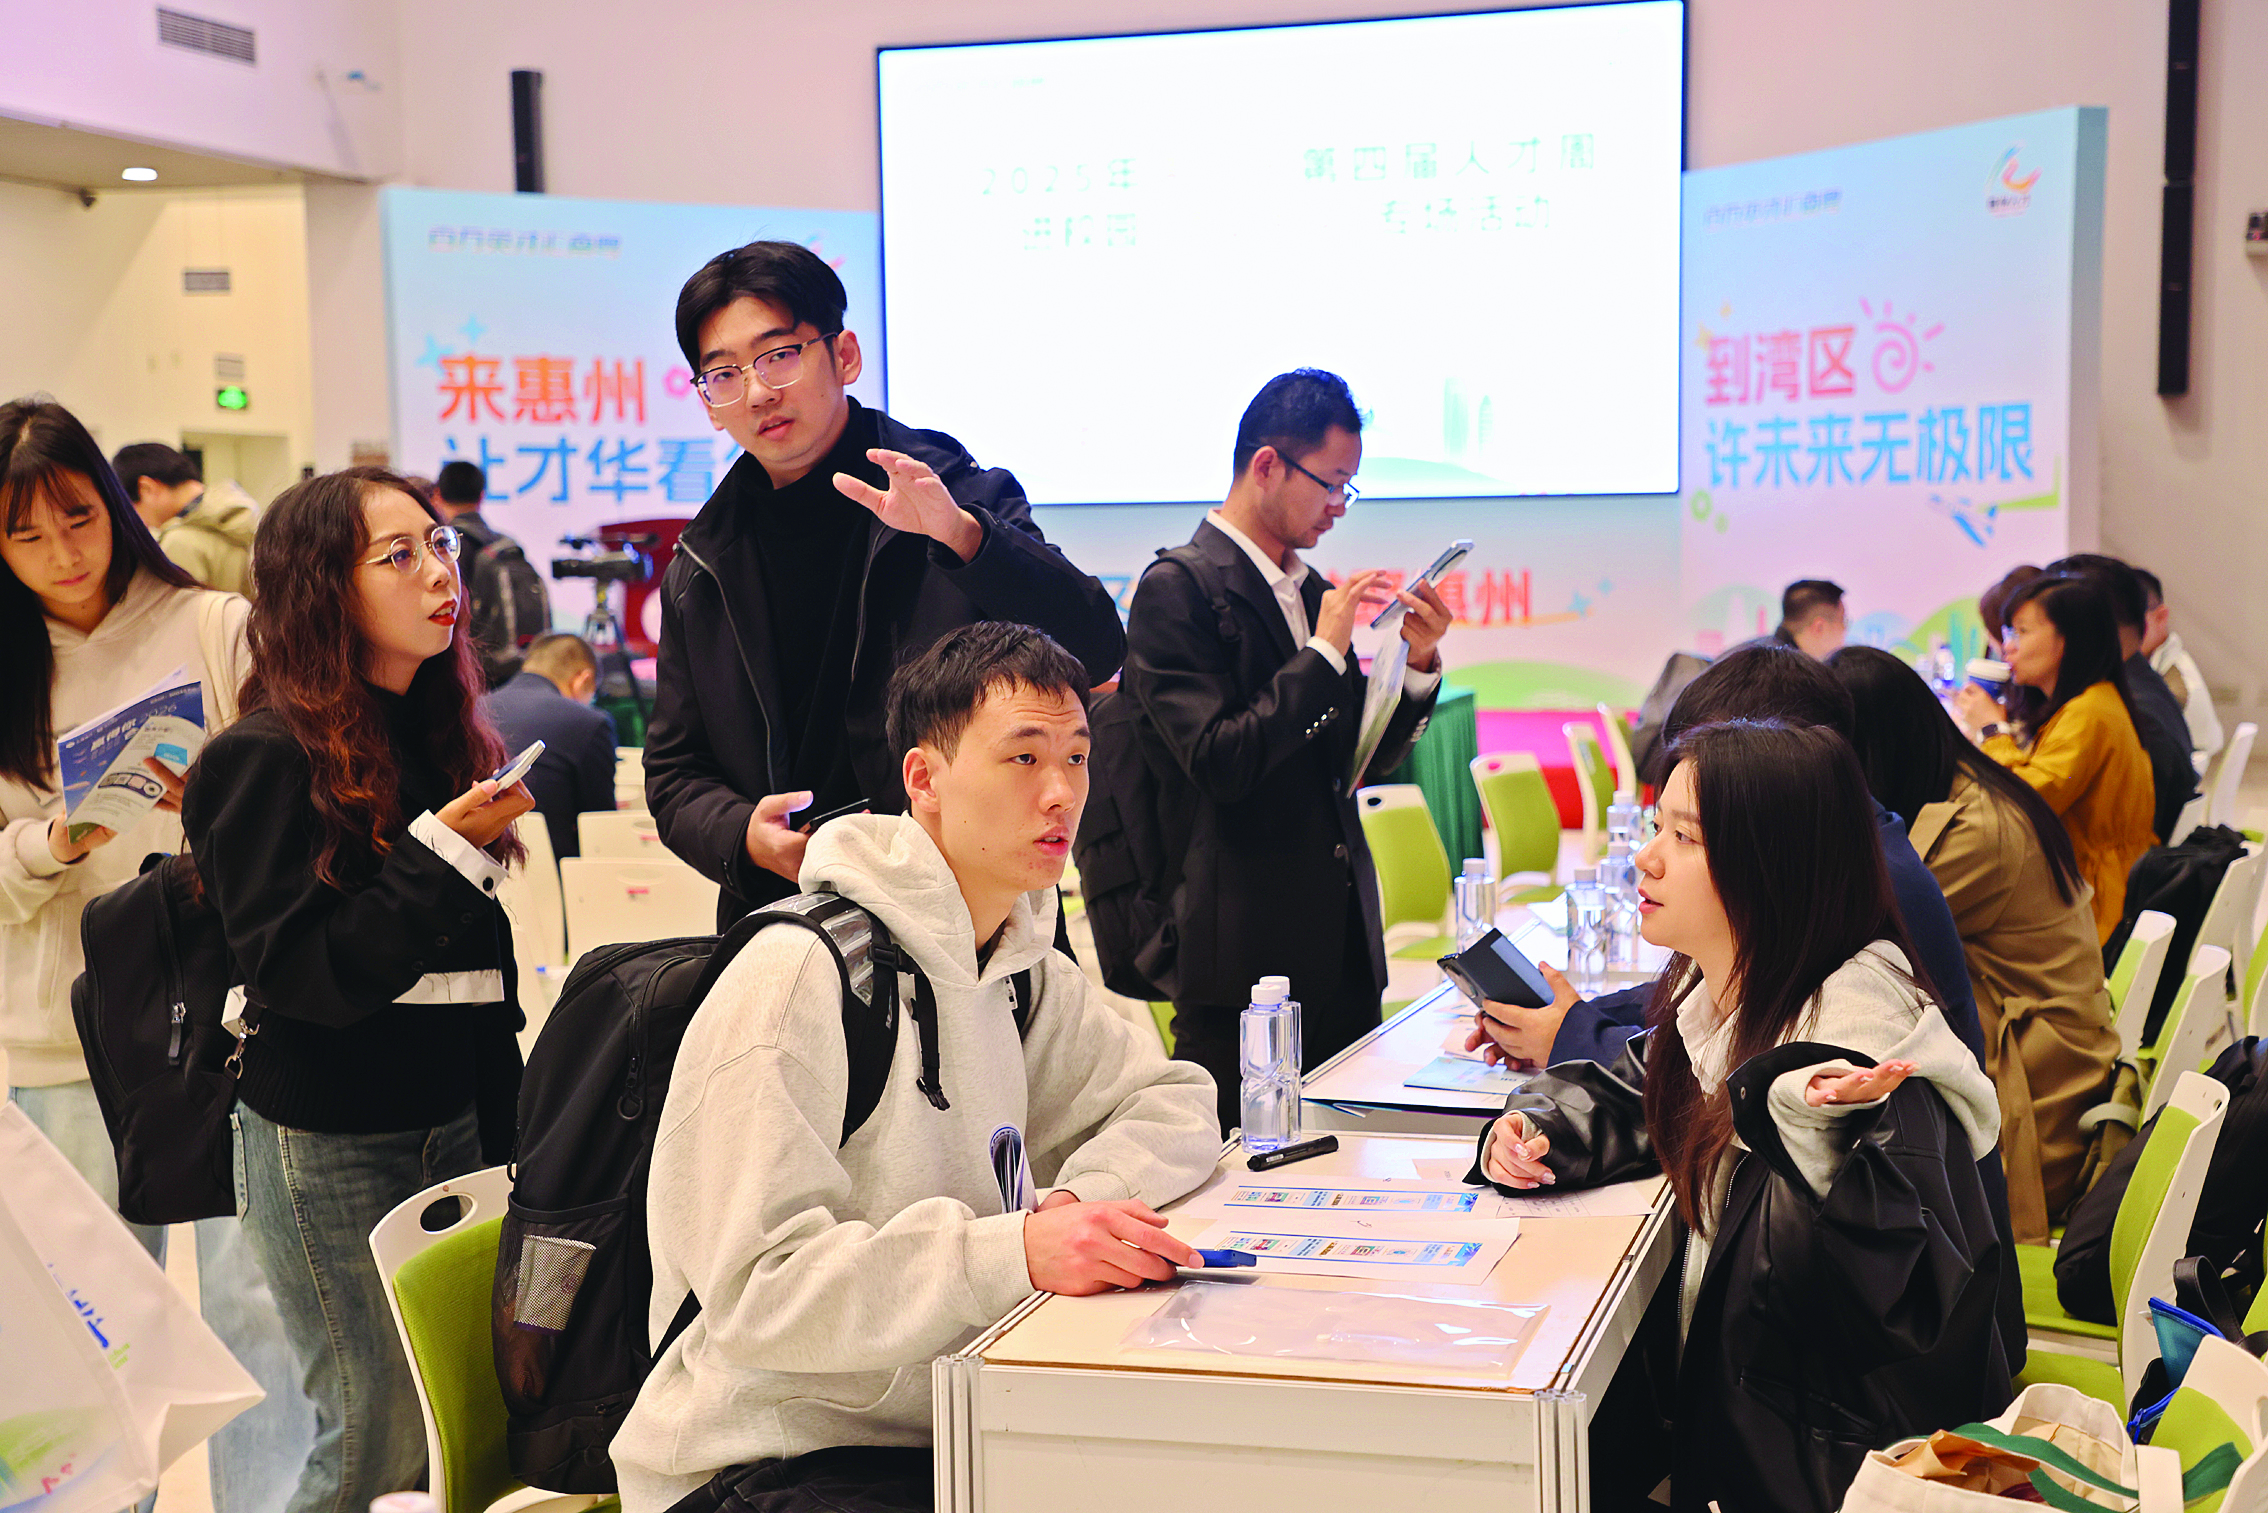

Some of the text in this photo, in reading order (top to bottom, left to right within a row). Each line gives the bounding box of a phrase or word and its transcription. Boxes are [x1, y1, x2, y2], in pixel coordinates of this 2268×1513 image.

[1302, 132, 1595, 183] 第四届人才周
[437, 354, 648, 427] 来惠州
[1704, 324, 1856, 407] 到湾区
[442, 436, 743, 503] 让才华看
[1703, 402, 2034, 488] 许未来无极限
